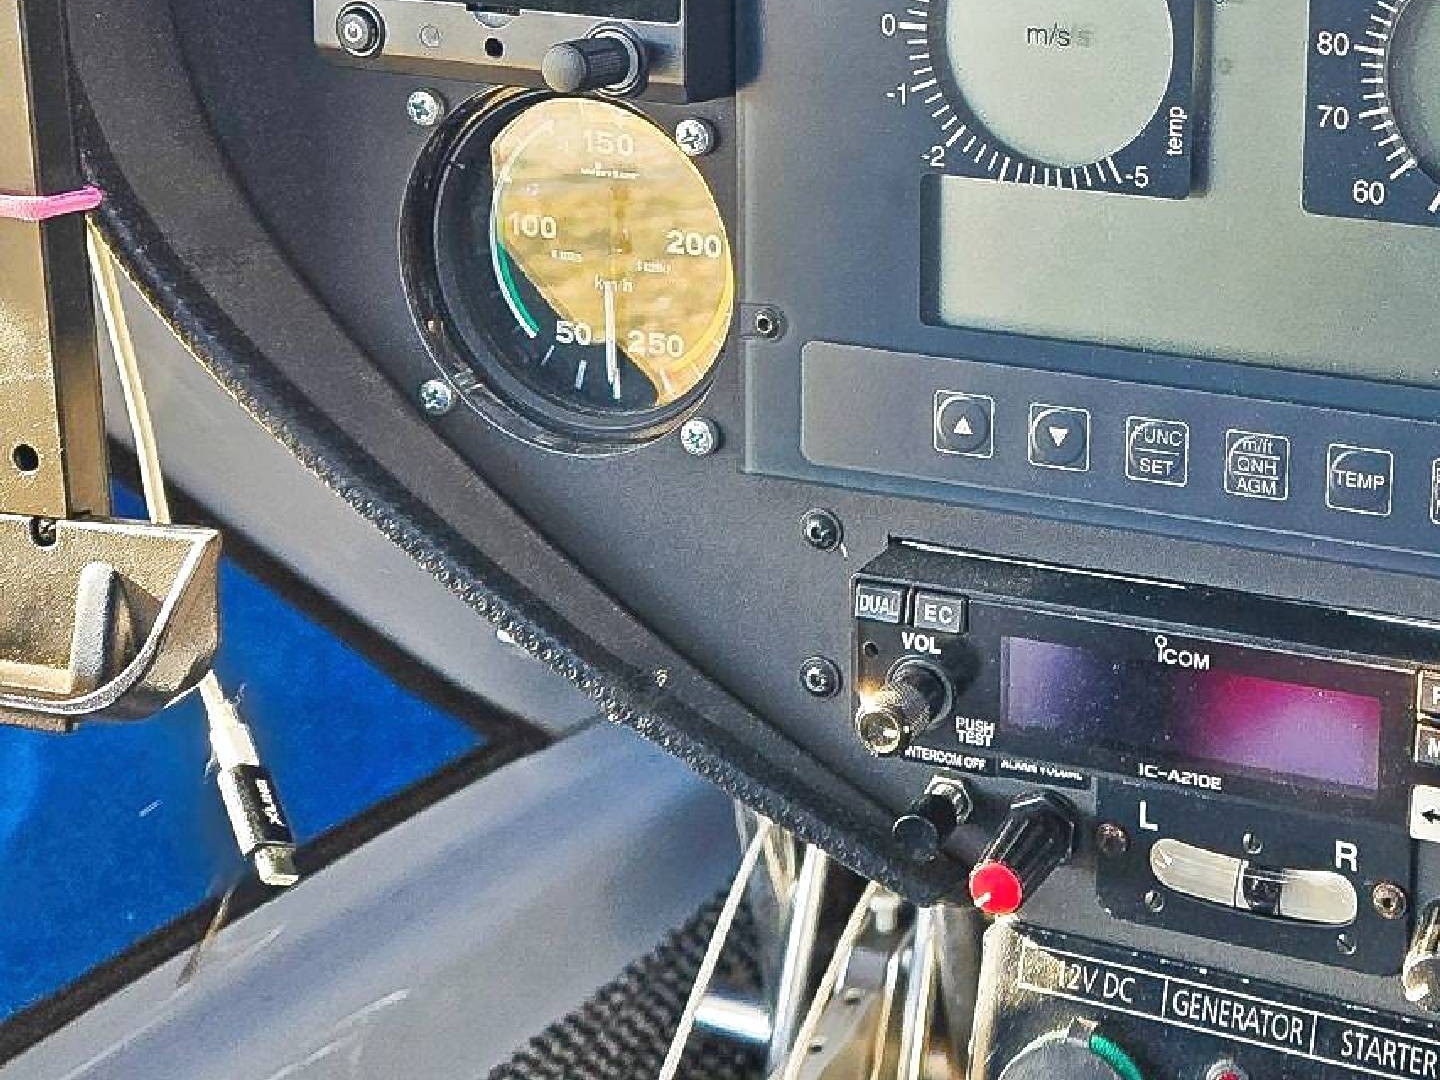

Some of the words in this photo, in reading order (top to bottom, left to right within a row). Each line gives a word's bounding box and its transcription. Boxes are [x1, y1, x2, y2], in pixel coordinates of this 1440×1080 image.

[880, 13, 897, 36] 0
[1026, 21, 1072, 49] m/s
[1316, 32, 1351, 58] 80
[886, 83, 908, 106] -1
[1166, 106, 1189, 156] temp
[1316, 105, 1351, 131] 70
[582, 130, 636, 157] 150
[921, 146, 946, 168] -2
[1124, 166, 1150, 189] -5
[1352, 180, 1386, 206] 60
[511, 213, 558, 239] 100
[665, 228, 723, 258] 200
[555, 319, 594, 347] 50
[626, 329, 685, 358] 250
[1133, 425, 1183, 448] FUNC
[1139, 456, 1174, 476] SET
[1237, 456, 1278, 476] QNH
[1333, 469, 1386, 492] TEMP
[859, 593, 899, 616] DUAL
[924, 602, 953, 624] EC
[901, 631, 942, 655] VOL
[954, 714, 996, 739] PUSH
[957, 729, 993, 747] TEST
[1137, 762, 1223, 791] IC-A210E
[1139, 799, 1159, 832] L
[1334, 839, 1359, 873] R
[1058, 959, 1099, 995] 12V
[1102, 971, 1137, 1005] DC
[1172, 989, 1304, 1047] GENERATOR
[1340, 1026, 1439, 1080] STARTER
